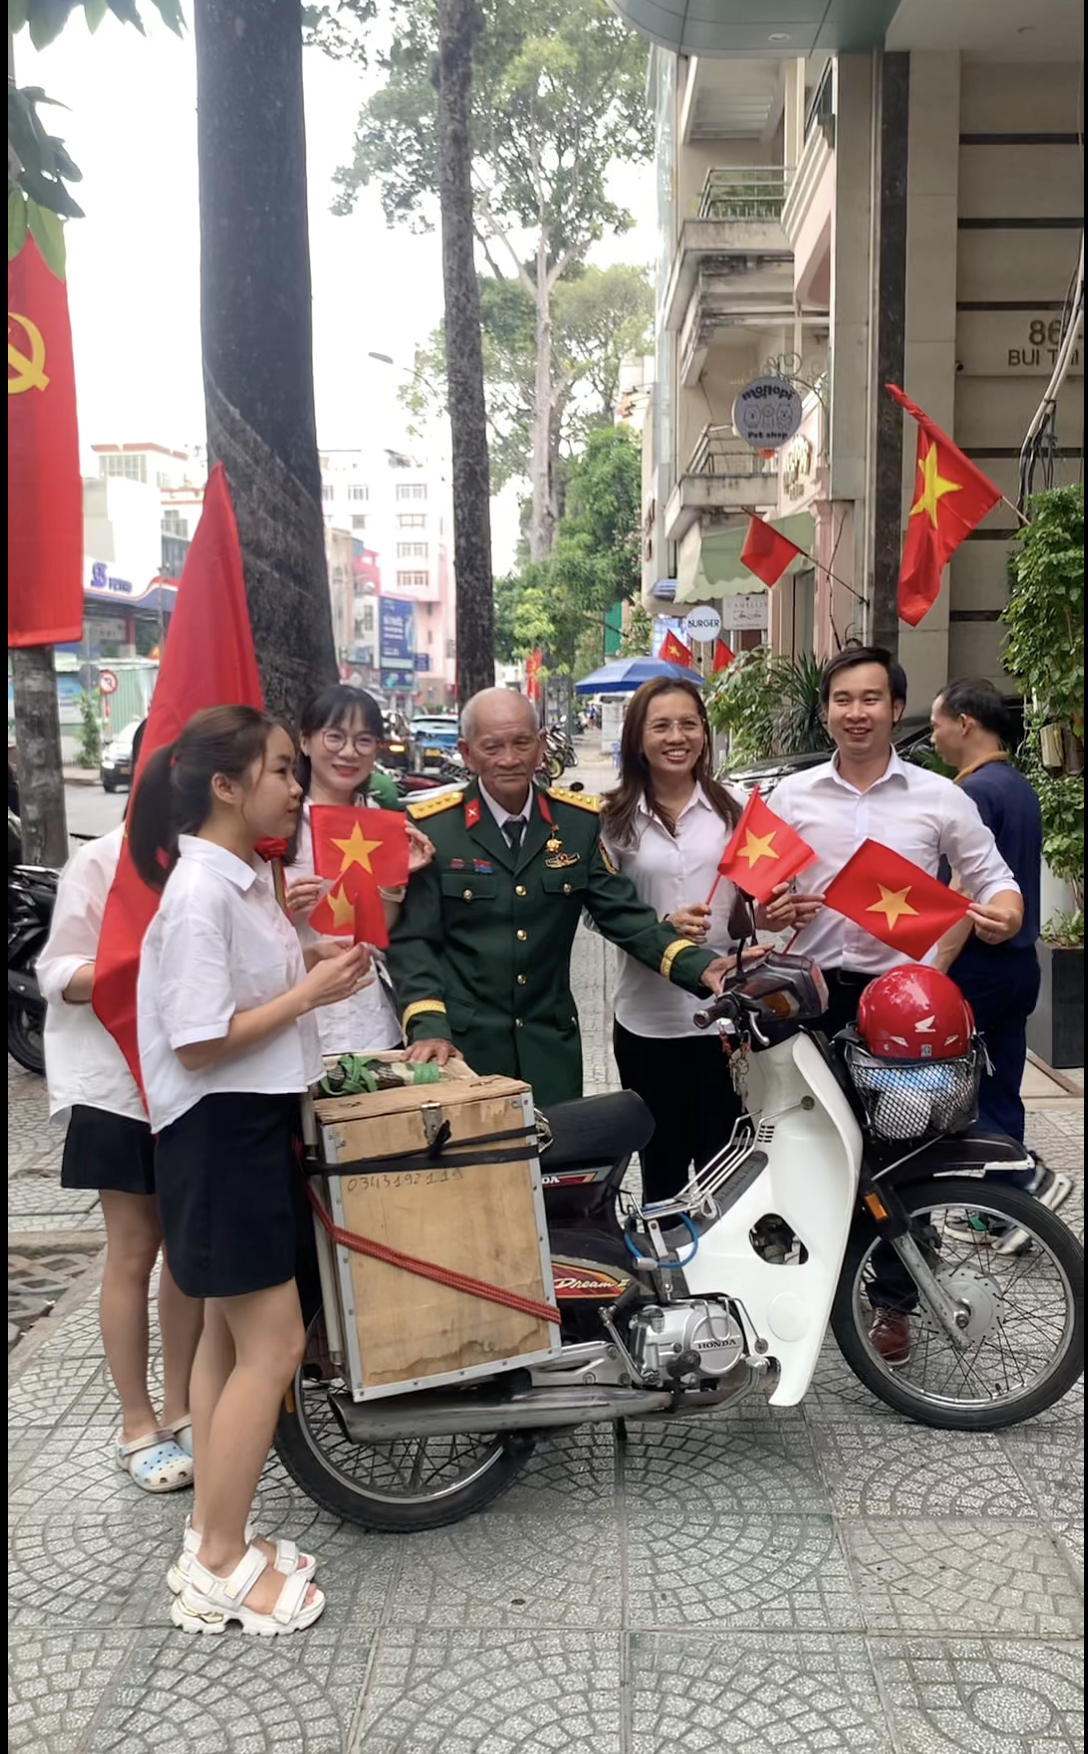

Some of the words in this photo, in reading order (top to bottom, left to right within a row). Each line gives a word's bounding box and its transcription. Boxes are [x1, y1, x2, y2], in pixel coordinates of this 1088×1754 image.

[1007, 348, 1040, 366] BUI
[748, 431, 763, 439] Pet
[766, 431, 788, 440] shop
[688, 619, 720, 629] BURGER
[553, 1277, 615, 1289] Dream
[697, 1339, 737, 1350] HONDA
